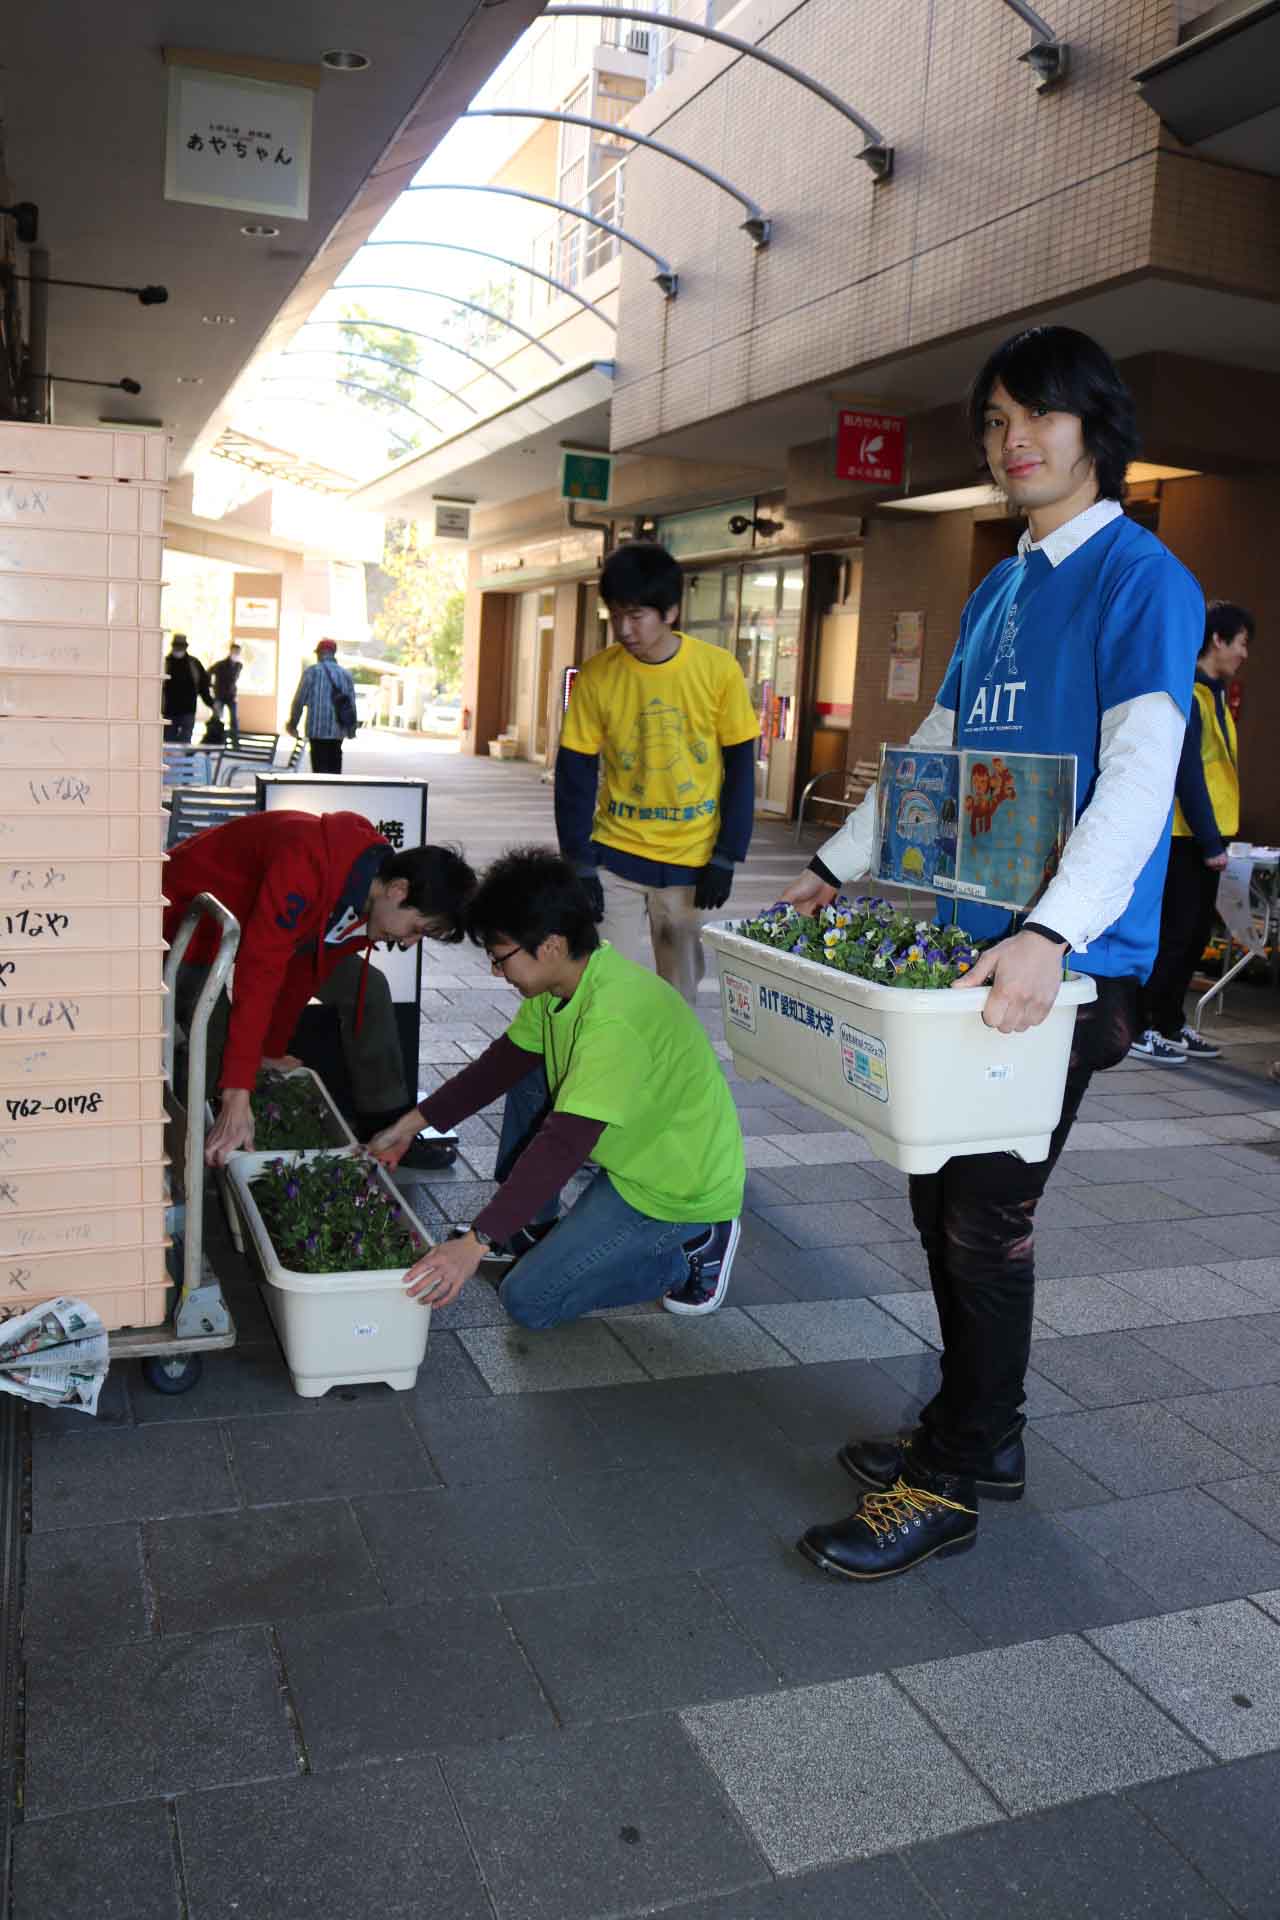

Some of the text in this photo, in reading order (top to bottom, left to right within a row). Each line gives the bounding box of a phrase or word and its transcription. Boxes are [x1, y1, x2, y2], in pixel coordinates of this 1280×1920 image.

[187, 133, 292, 165] あやちゃん
[966, 680, 1027, 725] AIT
[759, 986, 780, 1013] AIT
[780, 994, 834, 1038] 愛知工業大学
[6, 1092, 104, 1121] 762-0178
